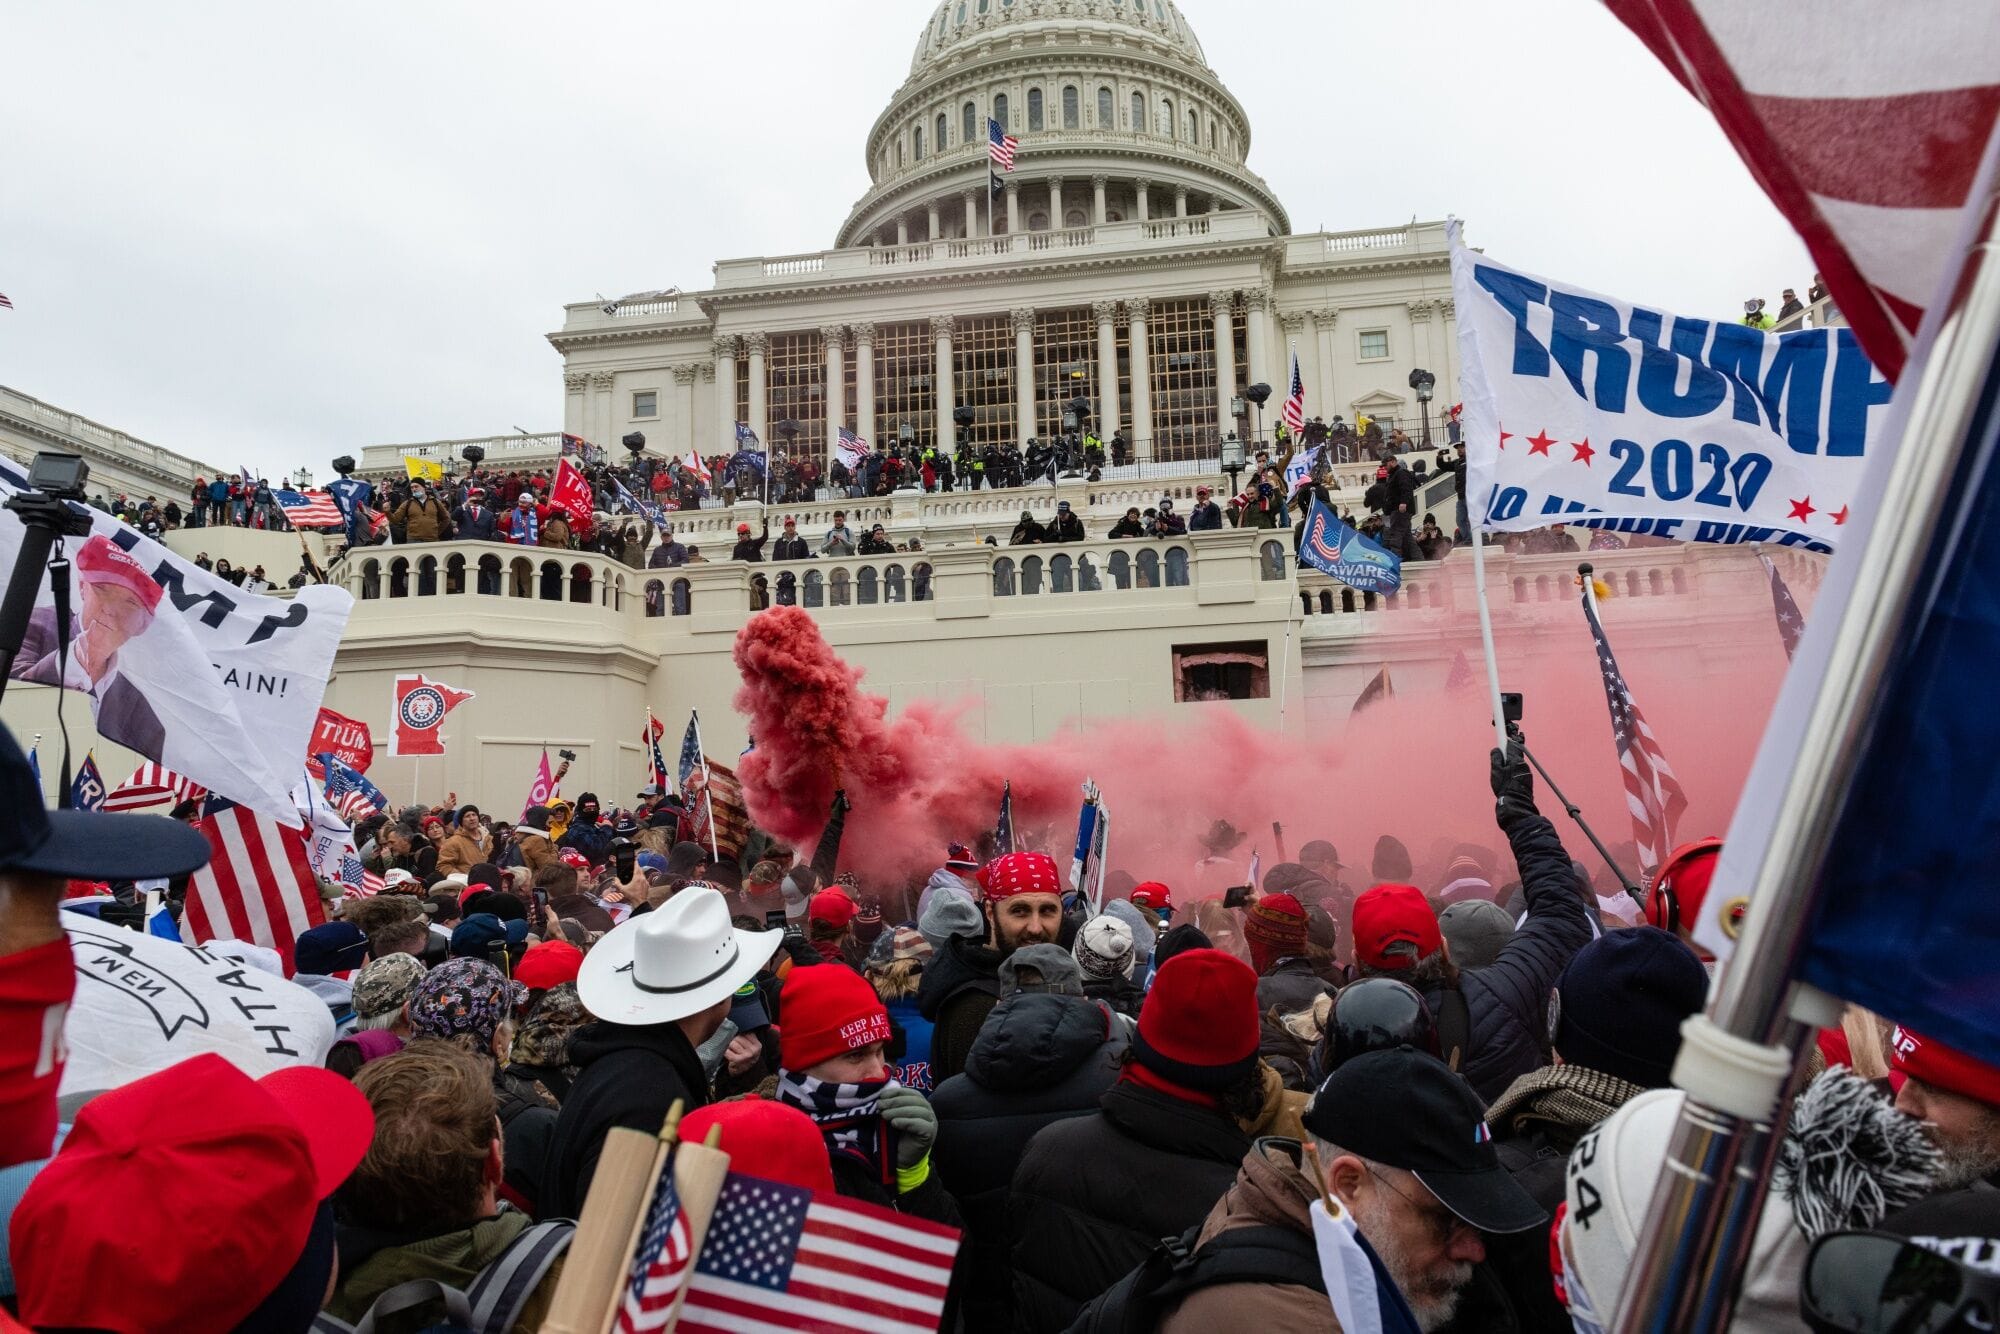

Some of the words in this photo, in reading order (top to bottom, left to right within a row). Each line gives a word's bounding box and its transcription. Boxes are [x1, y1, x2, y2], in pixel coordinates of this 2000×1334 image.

[1474, 264, 1891, 457] TRUMP
[1608, 439, 1773, 513] 2020
[212, 663, 288, 698] AIN!
[840, 1018, 867, 1039] KEEP
